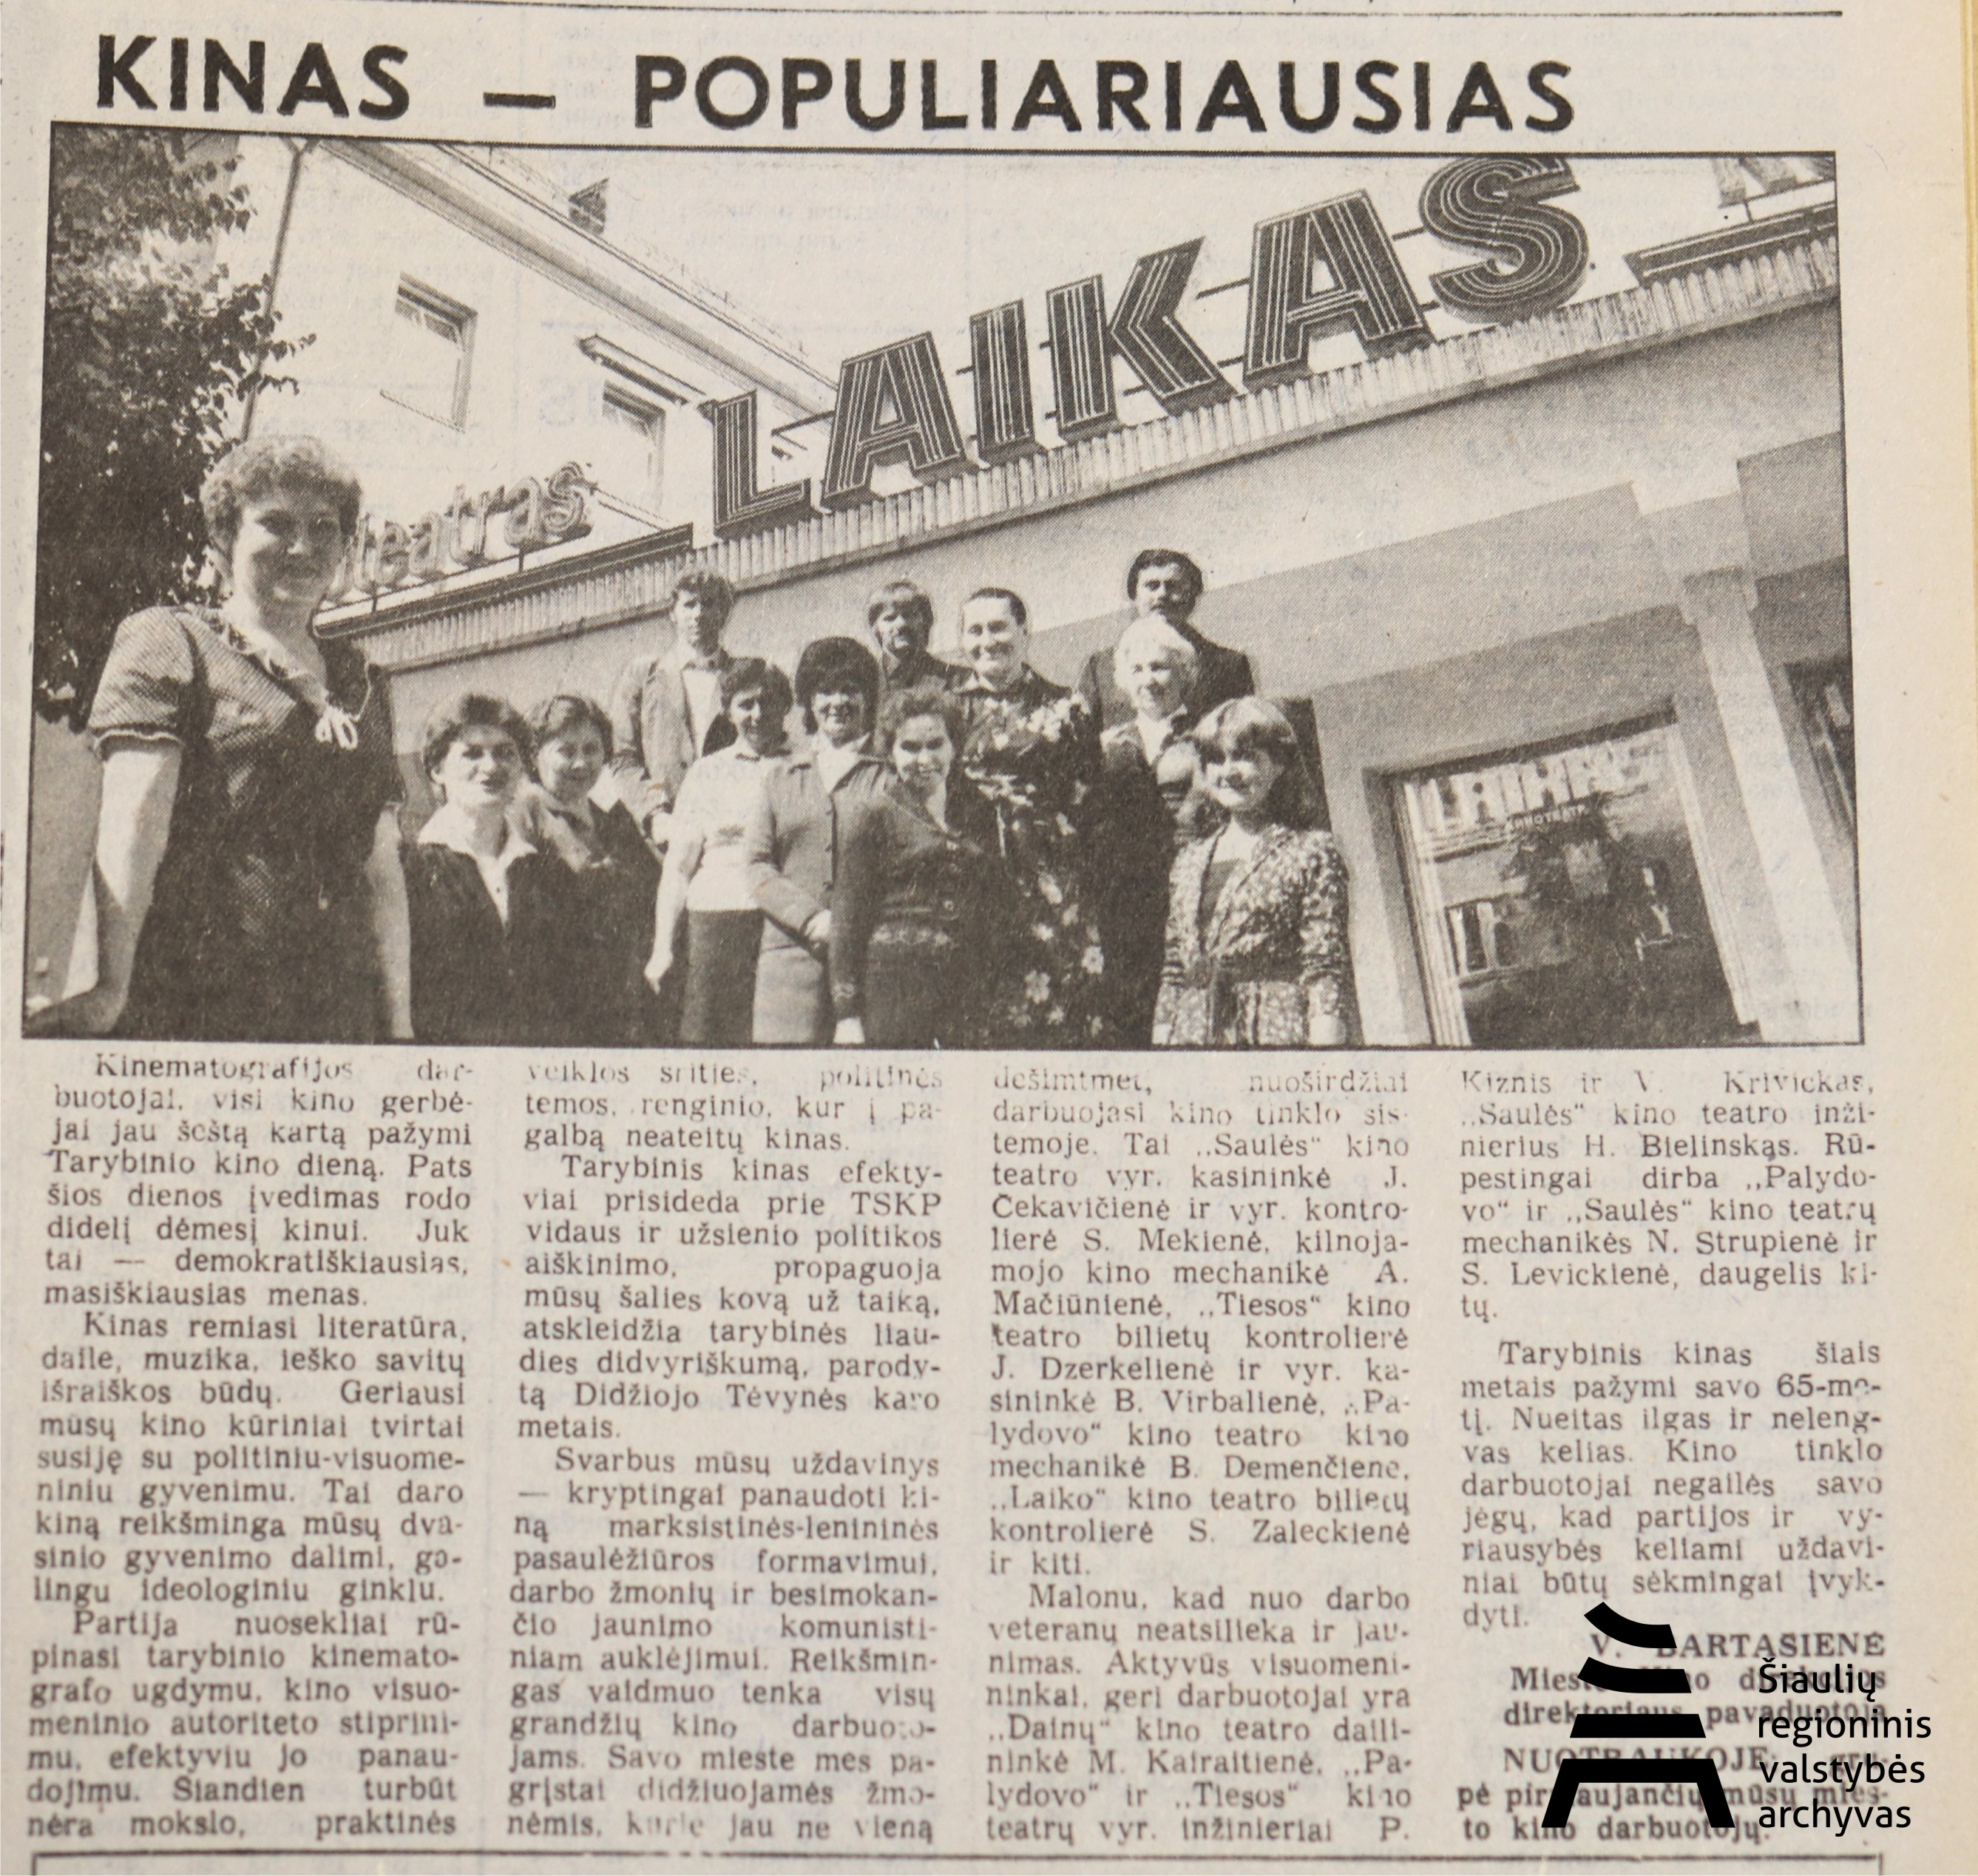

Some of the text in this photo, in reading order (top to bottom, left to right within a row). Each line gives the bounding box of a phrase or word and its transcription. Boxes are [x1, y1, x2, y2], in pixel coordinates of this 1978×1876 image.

[97, 35, 411, 120] KINAS
[634, 55, 1574, 134] POPULIARIAUSIAS
[703, 155, 1589, 537] LAIKAS
[524, 1122, 849, 1155] galbą neateitų kinas.
[49, 1148, 473, 1183] Tarybinio kino dieną. Pats
[560, 1153, 943, 1189] Tarybinis kinas efekty-
[992, 1162, 1407, 1191] teatro vyr. kasininkė J.
[1460, 1165, 1719, 1196] pestingai dirba
[47, 1182, 471, 1215] šios dienos įvedimas rodo
[523, 1188, 942, 1220] viai prisideda prie TSKP
[992, 1193, 1409, 1226] Čekavičienė ir vyr. kontro-
[1526, 1198, 1773, 1222] ir kino
[47, 1214, 470, 1247] didelį dėmesį kinui. Juk
[526, 1219, 942, 1253] vidaus ir užsienio politikos
[1462, 1228, 1877, 1259] mechanikės N. Strupienė ir
[991, 1258, 1408, 1287] mojo kino mechanikė A.
[1462, 1260, 1822, 1292] S. Levickienė, daugelis
[524, 1285, 601, 1315] mūsų
[619, 1284, 702, 1312] šalies
[719, 1286, 789, 1317] kovą
[807, 1289, 839, 1313] už
[84, 1310, 467, 1343] Kinas remiasi literatūra,
[523, 1315, 847, 1349] atskleidžia tarybinės
[1116, 1322, 1409, 1355] bilietų kontrolierė
[991, 1353, 1341, 1387] J. Dzerkelienė ir vyr.
[1498, 1339, 1880, 1371] Tarybinis kinas šiais
[42, 1378, 464, 1410] išraiškos būdų. Geriausi
[141, 1411, 464, 1439] kino kūriniai tvirtai
[518, 1415, 620, 1439] metais.
[1460, 1406, 1882, 1437] tį. Nueitas ilgas ir neleng-
[1462, 1437, 1883, 1465] vas kelias. Kino tinklo
[1461, 1471, 1883, 1501] darbuotojai negailės savo
[35, 1509, 101, 1542] kiną
[120, 1509, 286, 1543] reikšminga
[400, 1511, 462, 1537] dva-
[514, 1513, 939, 1544] ną marksistinės-lenininės
[990, 1517, 1410, 1545] kontrolierė S. Zaleckienė
[1560, 1503, 1883, 1534] kad partijos ir vy-
[989, 1550, 1090, 1576] ir kiti.
[1462, 1534, 1884, 1568] riausybės keliami uždavi-
[35, 1576, 444, 1609] lingu ideologiniu ginklu.
[509, 1577, 938, 1611] darbo žmonių ir besimokan-
[1172, 1585, 1410, 1612] kad nuo darbo
[1463, 1568, 1783, 1600] niai būtų sėkmingai
[31, 1642, 459, 1676] pinasi tarybinio kinemato-
[989, 1650, 1081, 1675] nimas.
[1251, 1653, 1410, 1676] visuomeni-
[510, 1678, 935, 1713] gas vaidmuo tenka visų
[316, 1809, 457, 1841] praktinės
[986, 1815, 1409, 1847] teatrų vyr. inžinieriai P.
[1463, 1816, 1491, 1840] to
